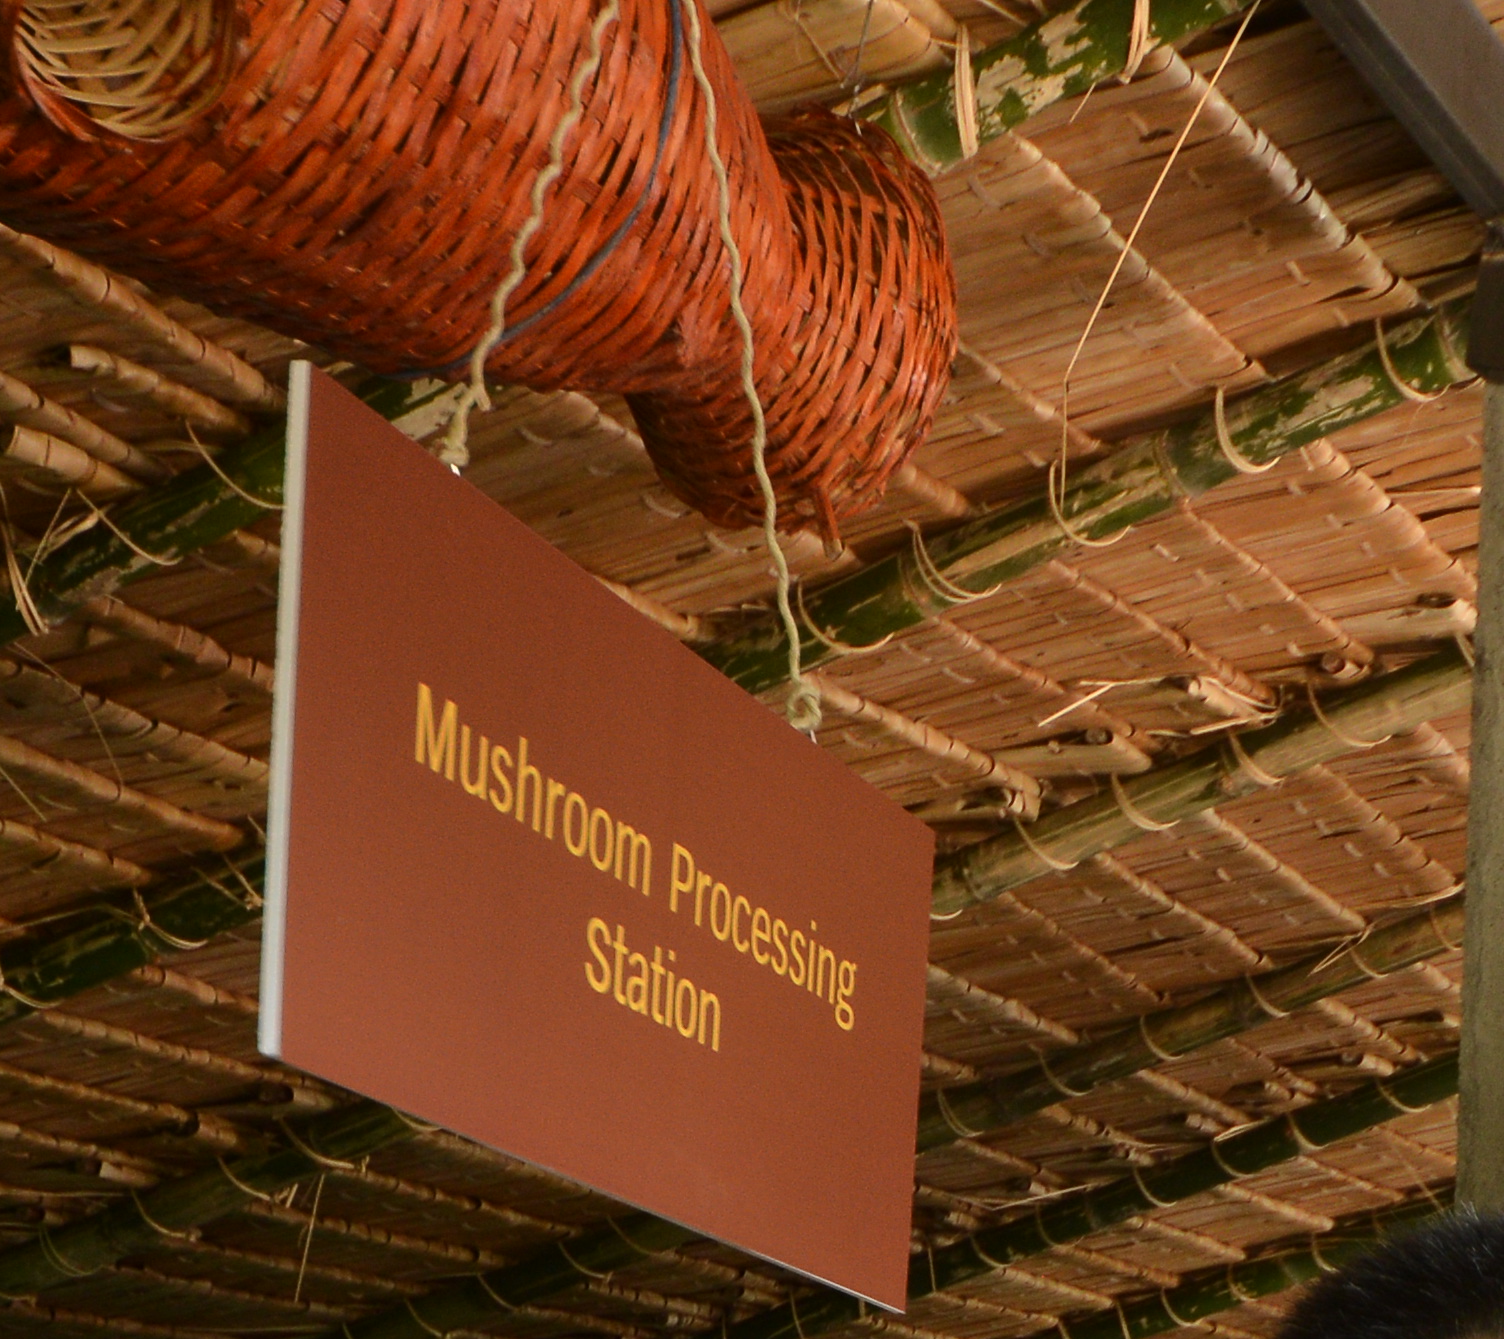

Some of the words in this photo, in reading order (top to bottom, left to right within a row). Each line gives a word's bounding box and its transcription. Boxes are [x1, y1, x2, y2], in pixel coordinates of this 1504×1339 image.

[415, 682, 652, 896] Mushroom
[669, 842, 857, 1031] Processing
[584, 917, 721, 1052] Station
